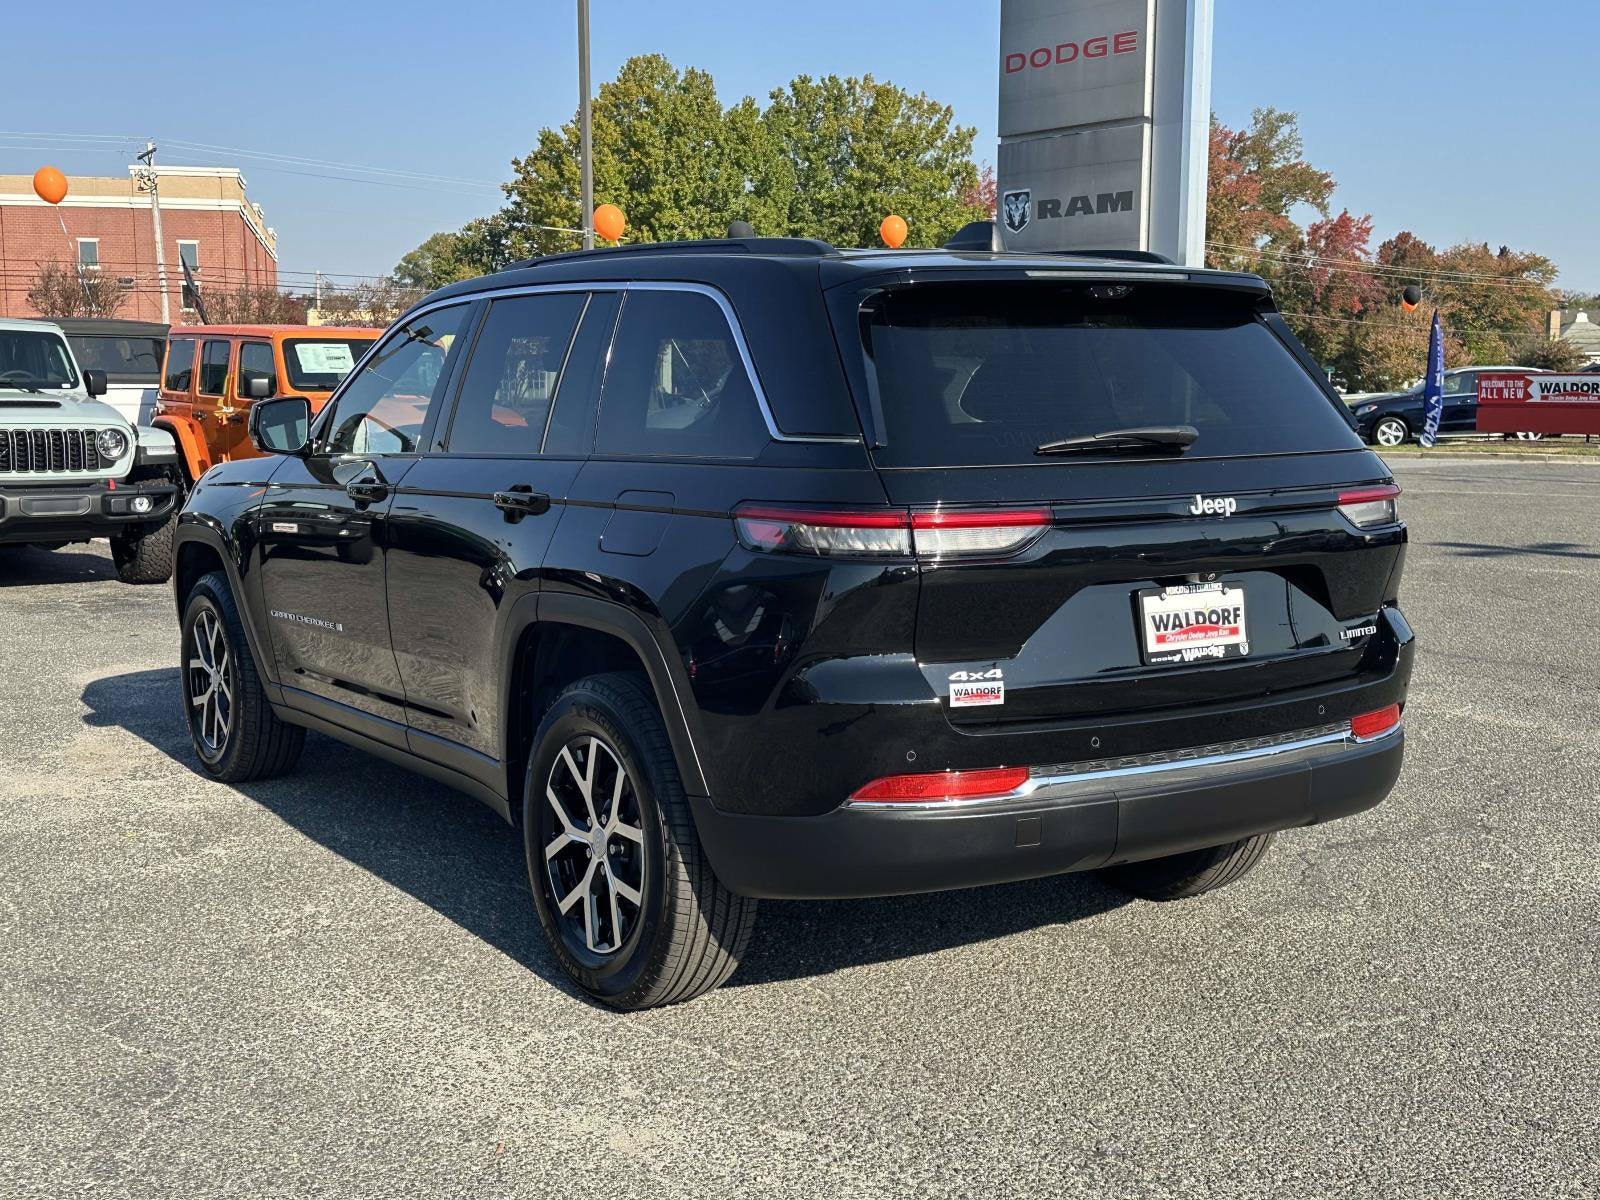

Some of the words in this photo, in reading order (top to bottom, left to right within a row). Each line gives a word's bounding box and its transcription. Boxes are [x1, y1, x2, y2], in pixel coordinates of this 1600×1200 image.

[1005, 31, 1138, 74] DODGE
[1037, 191, 1133, 220] RAM
[1481, 380, 1505, 388] WELCOME
[1507, 380, 1514, 388] TO
[1515, 380, 1525, 388] THE
[1481, 388, 1498, 399] ALL
[1503, 388, 1525, 399] NEW
[1190, 494, 1237, 517] Jeep
[270, 609, 295, 621] GRAND
[296, 614, 335, 630] CHEROKEE
[1150, 606, 1241, 633] WALDORF
[1340, 625, 1377, 640] LIMITED
[948, 668, 1004, 681] 4x4
[953, 686, 1002, 697] WALDORF
